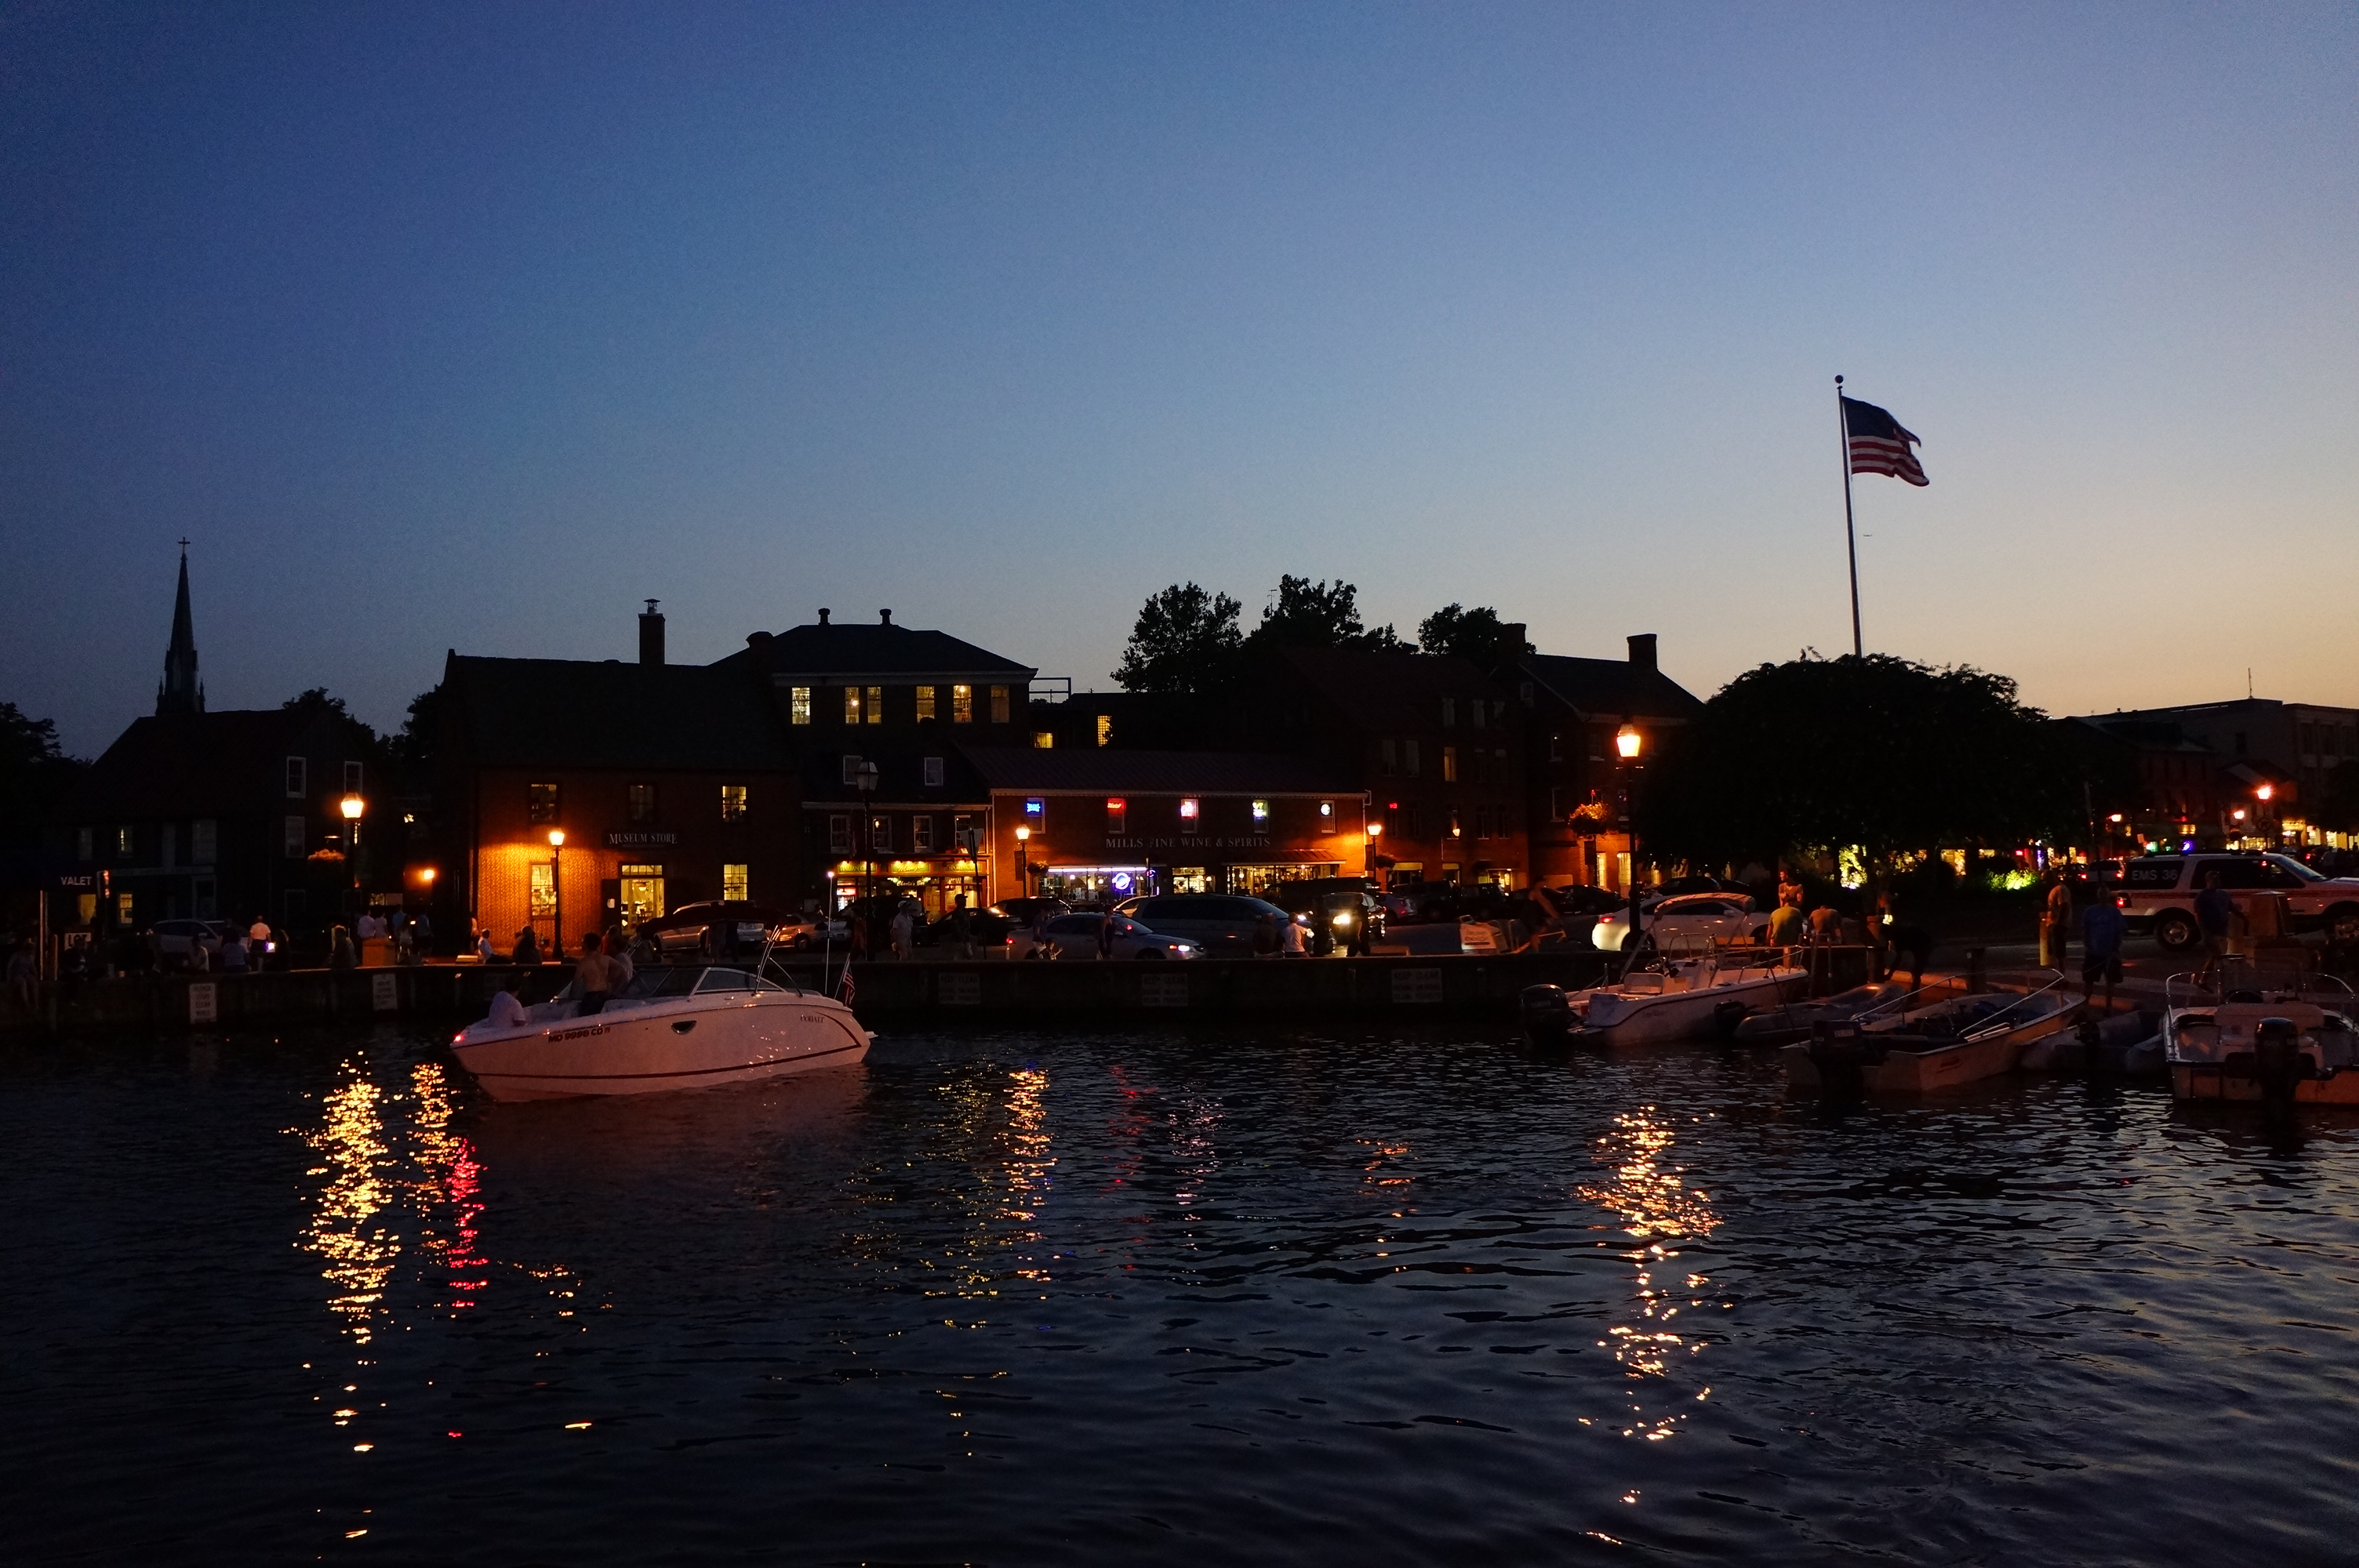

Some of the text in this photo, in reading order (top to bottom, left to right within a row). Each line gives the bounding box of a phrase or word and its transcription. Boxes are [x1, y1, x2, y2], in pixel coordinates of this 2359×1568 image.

[609, 833, 678, 844] MUSEUM STORE
[1106, 837, 1270, 848] MILLS FINE WINE & SPIRITS
[2132, 869, 2157, 880] EMS
[60, 876, 92, 886] VALET
[1394, 971, 1438, 980] KEEP CLEAR
[548, 1034, 563, 1043] MD
